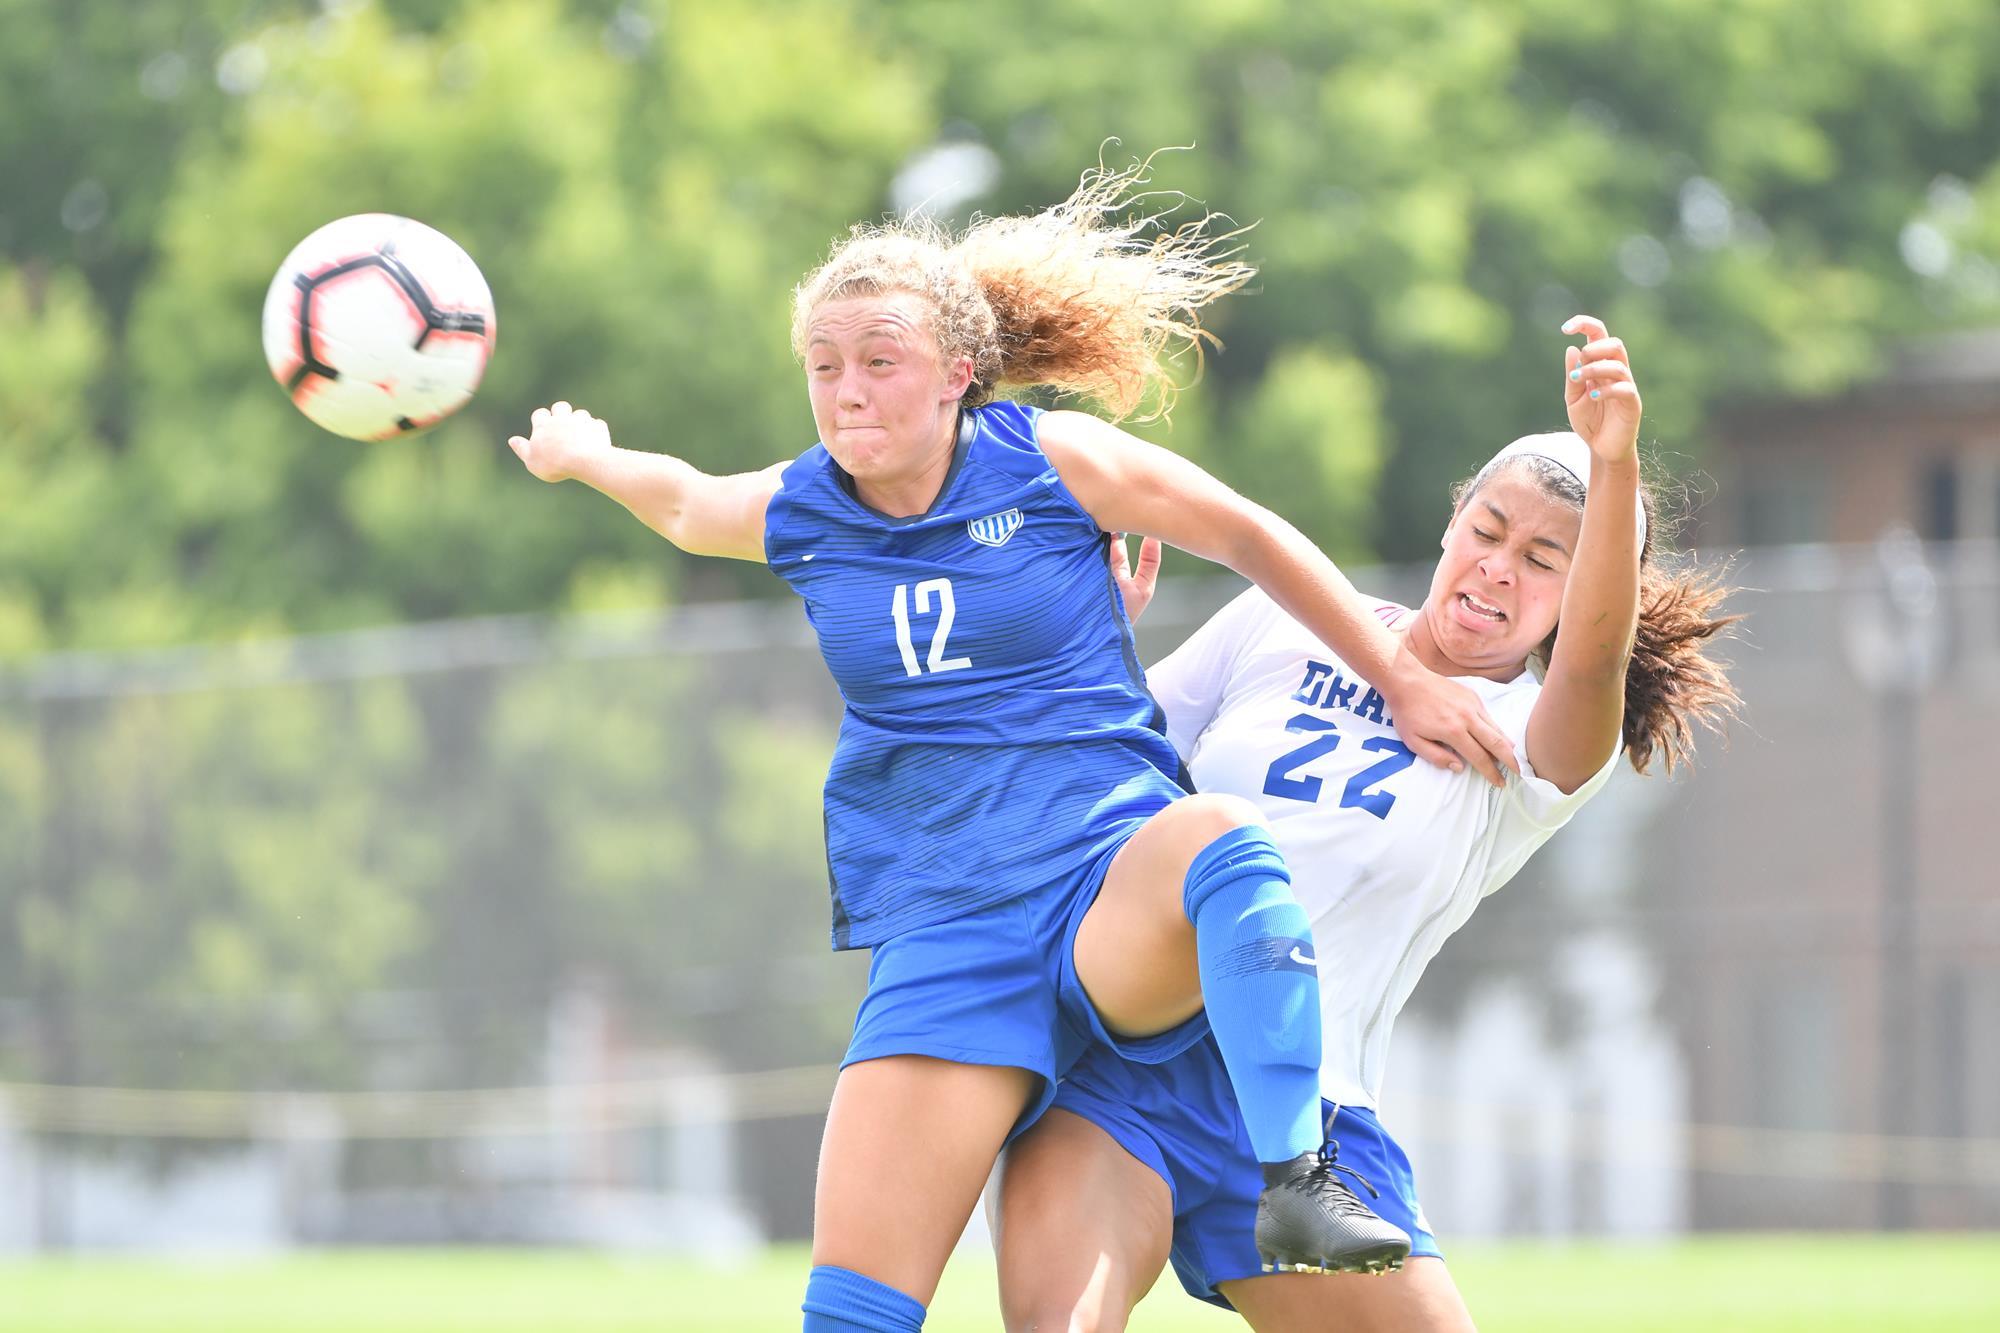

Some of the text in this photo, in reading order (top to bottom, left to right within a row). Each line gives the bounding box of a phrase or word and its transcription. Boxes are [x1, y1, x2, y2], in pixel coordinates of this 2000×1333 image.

[891, 577, 972, 677] 12
[1291, 660, 1394, 727] DRA
[1263, 713, 1416, 820] 22
